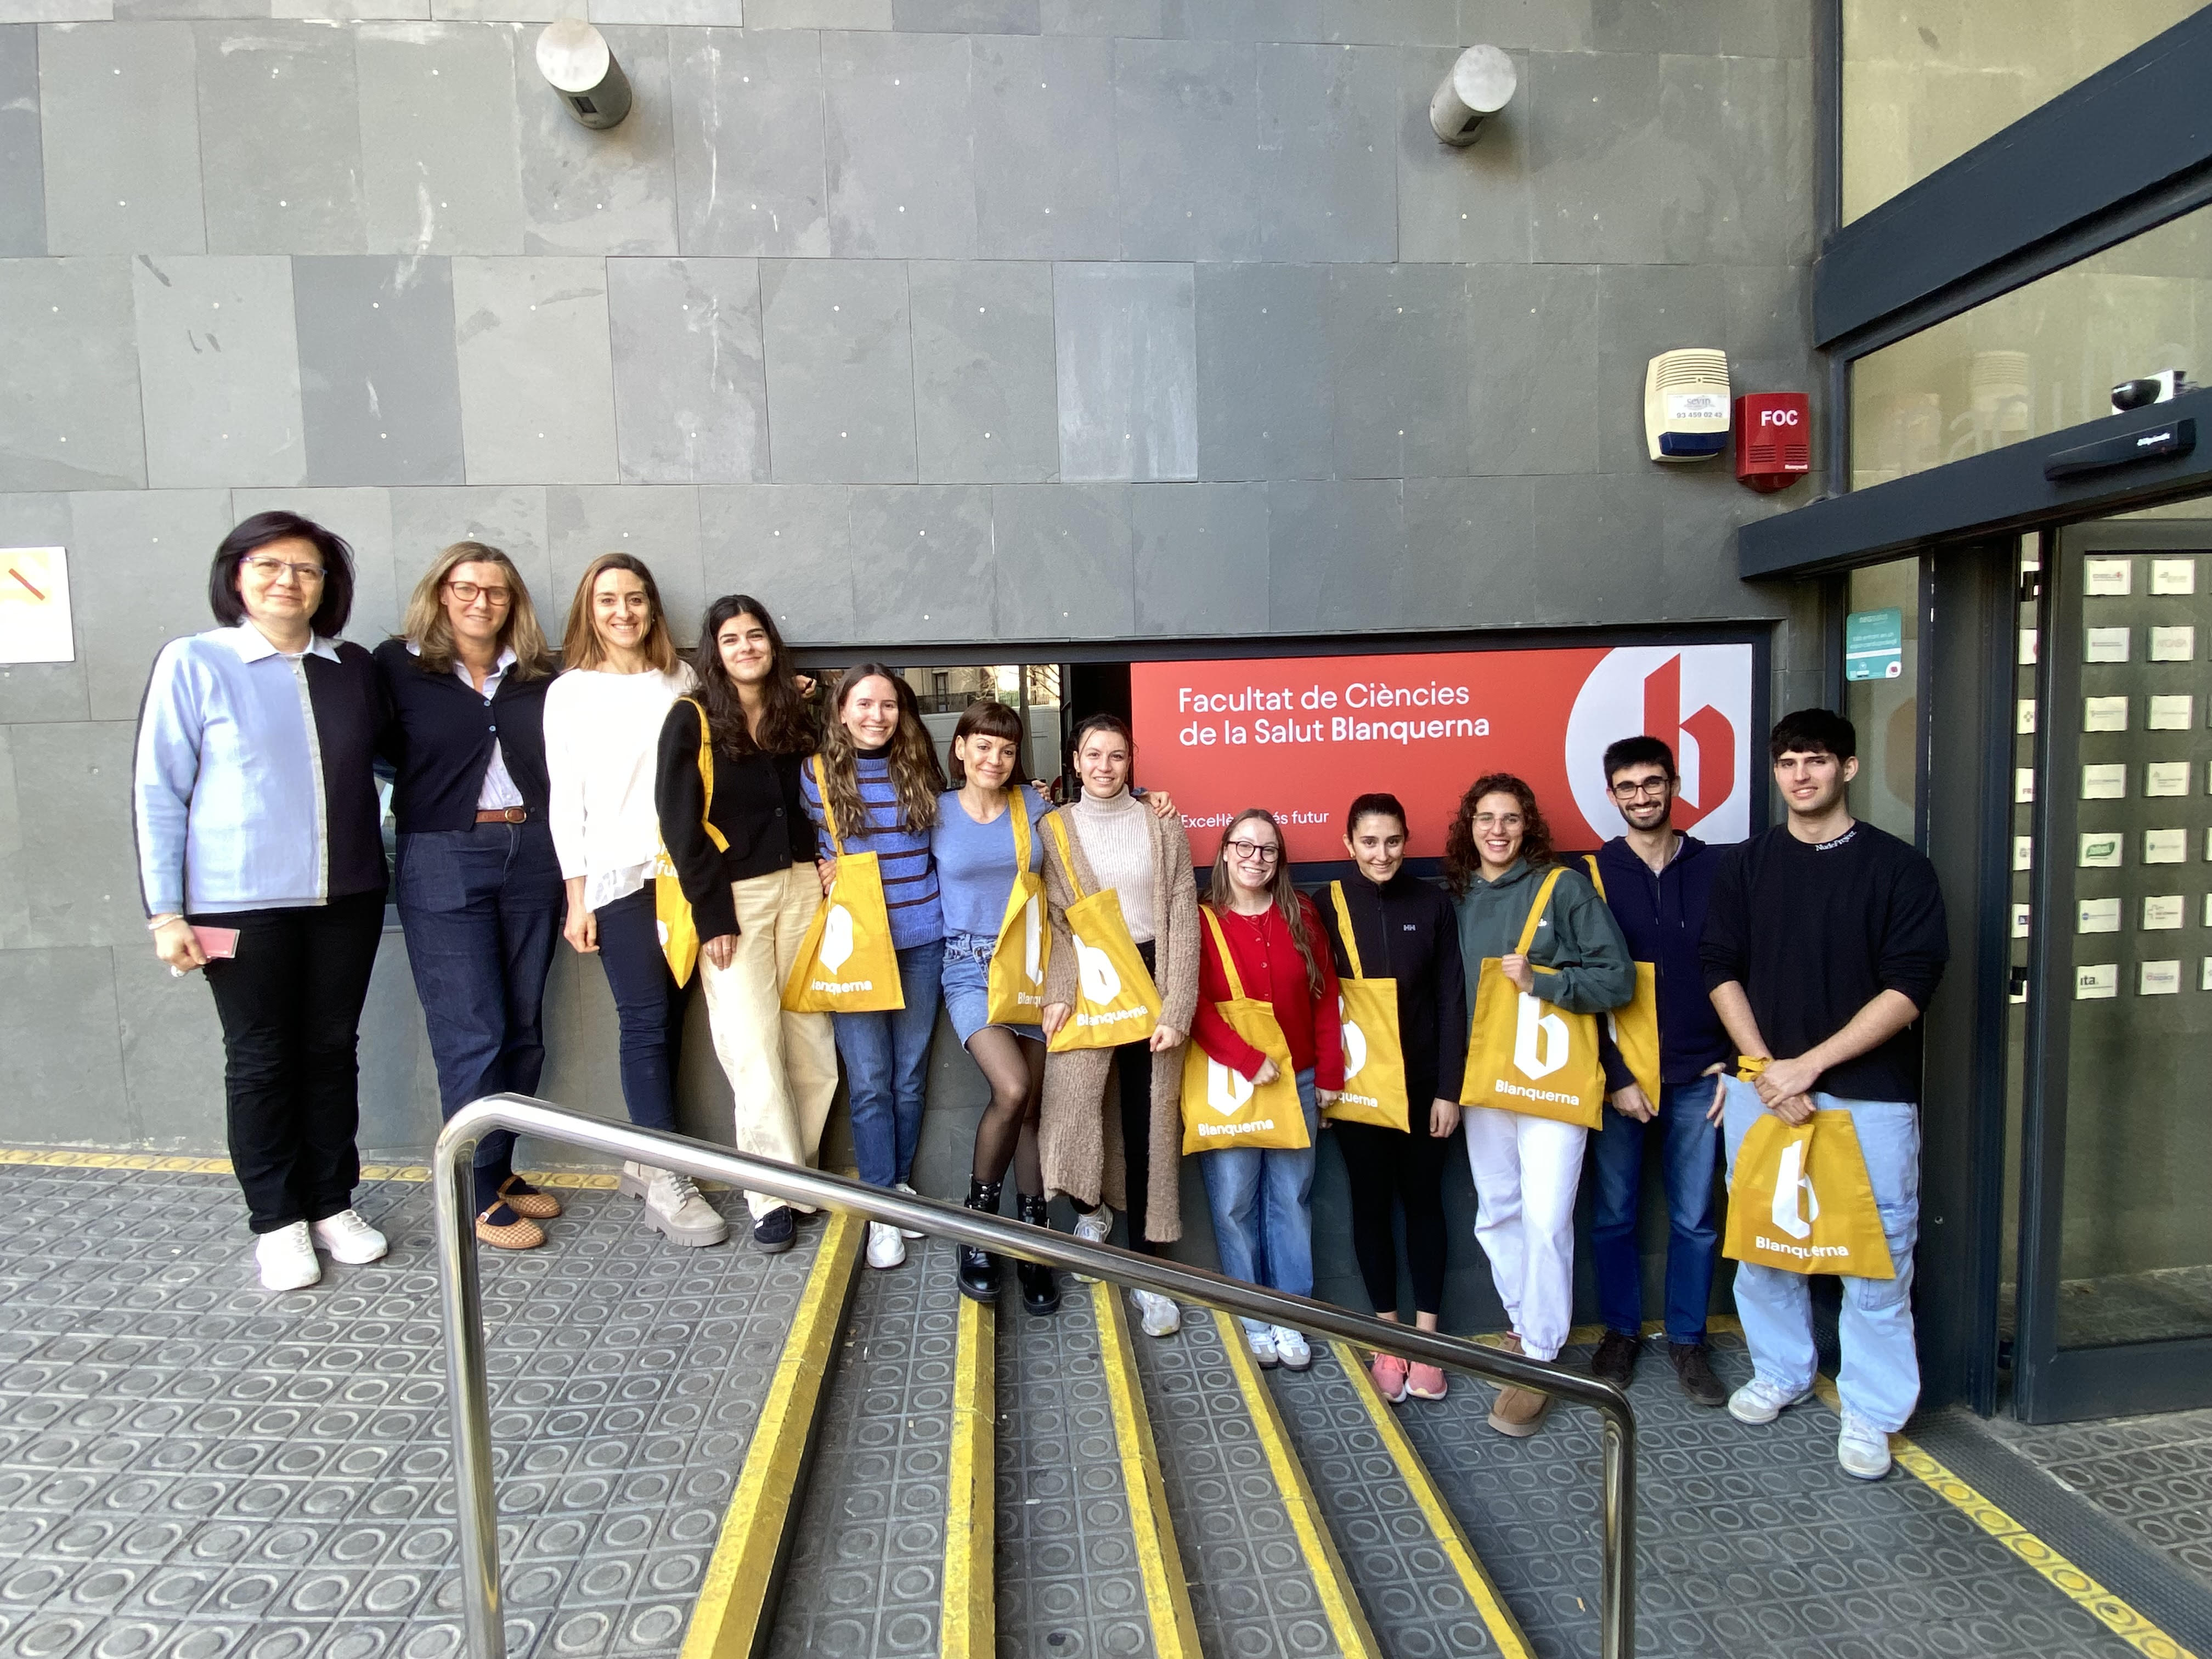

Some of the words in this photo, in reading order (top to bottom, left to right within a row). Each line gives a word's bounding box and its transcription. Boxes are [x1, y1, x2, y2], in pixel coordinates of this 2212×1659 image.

[1761, 409, 1798, 426] FOC
[1178, 686, 1293, 713] Facultat
[1301, 685, 1338, 709] de
[1345, 680, 1470, 708] Ciències
[1179, 721, 1217, 746] de
[1224, 720, 1247, 744] la
[1254, 718, 1324, 744] Salut
[1331, 716, 1491, 744] Blanquerna
[1291, 810, 1329, 824] futur
[1076, 1005, 1148, 1026] Blanquerna
[1339, 1092, 1379, 1108] querna
[1495, 1079, 1579, 1105] Blanquerna
[1198, 1119, 1274, 1136] Blanquerna
[1756, 1236, 1849, 1259] Blanquerna
